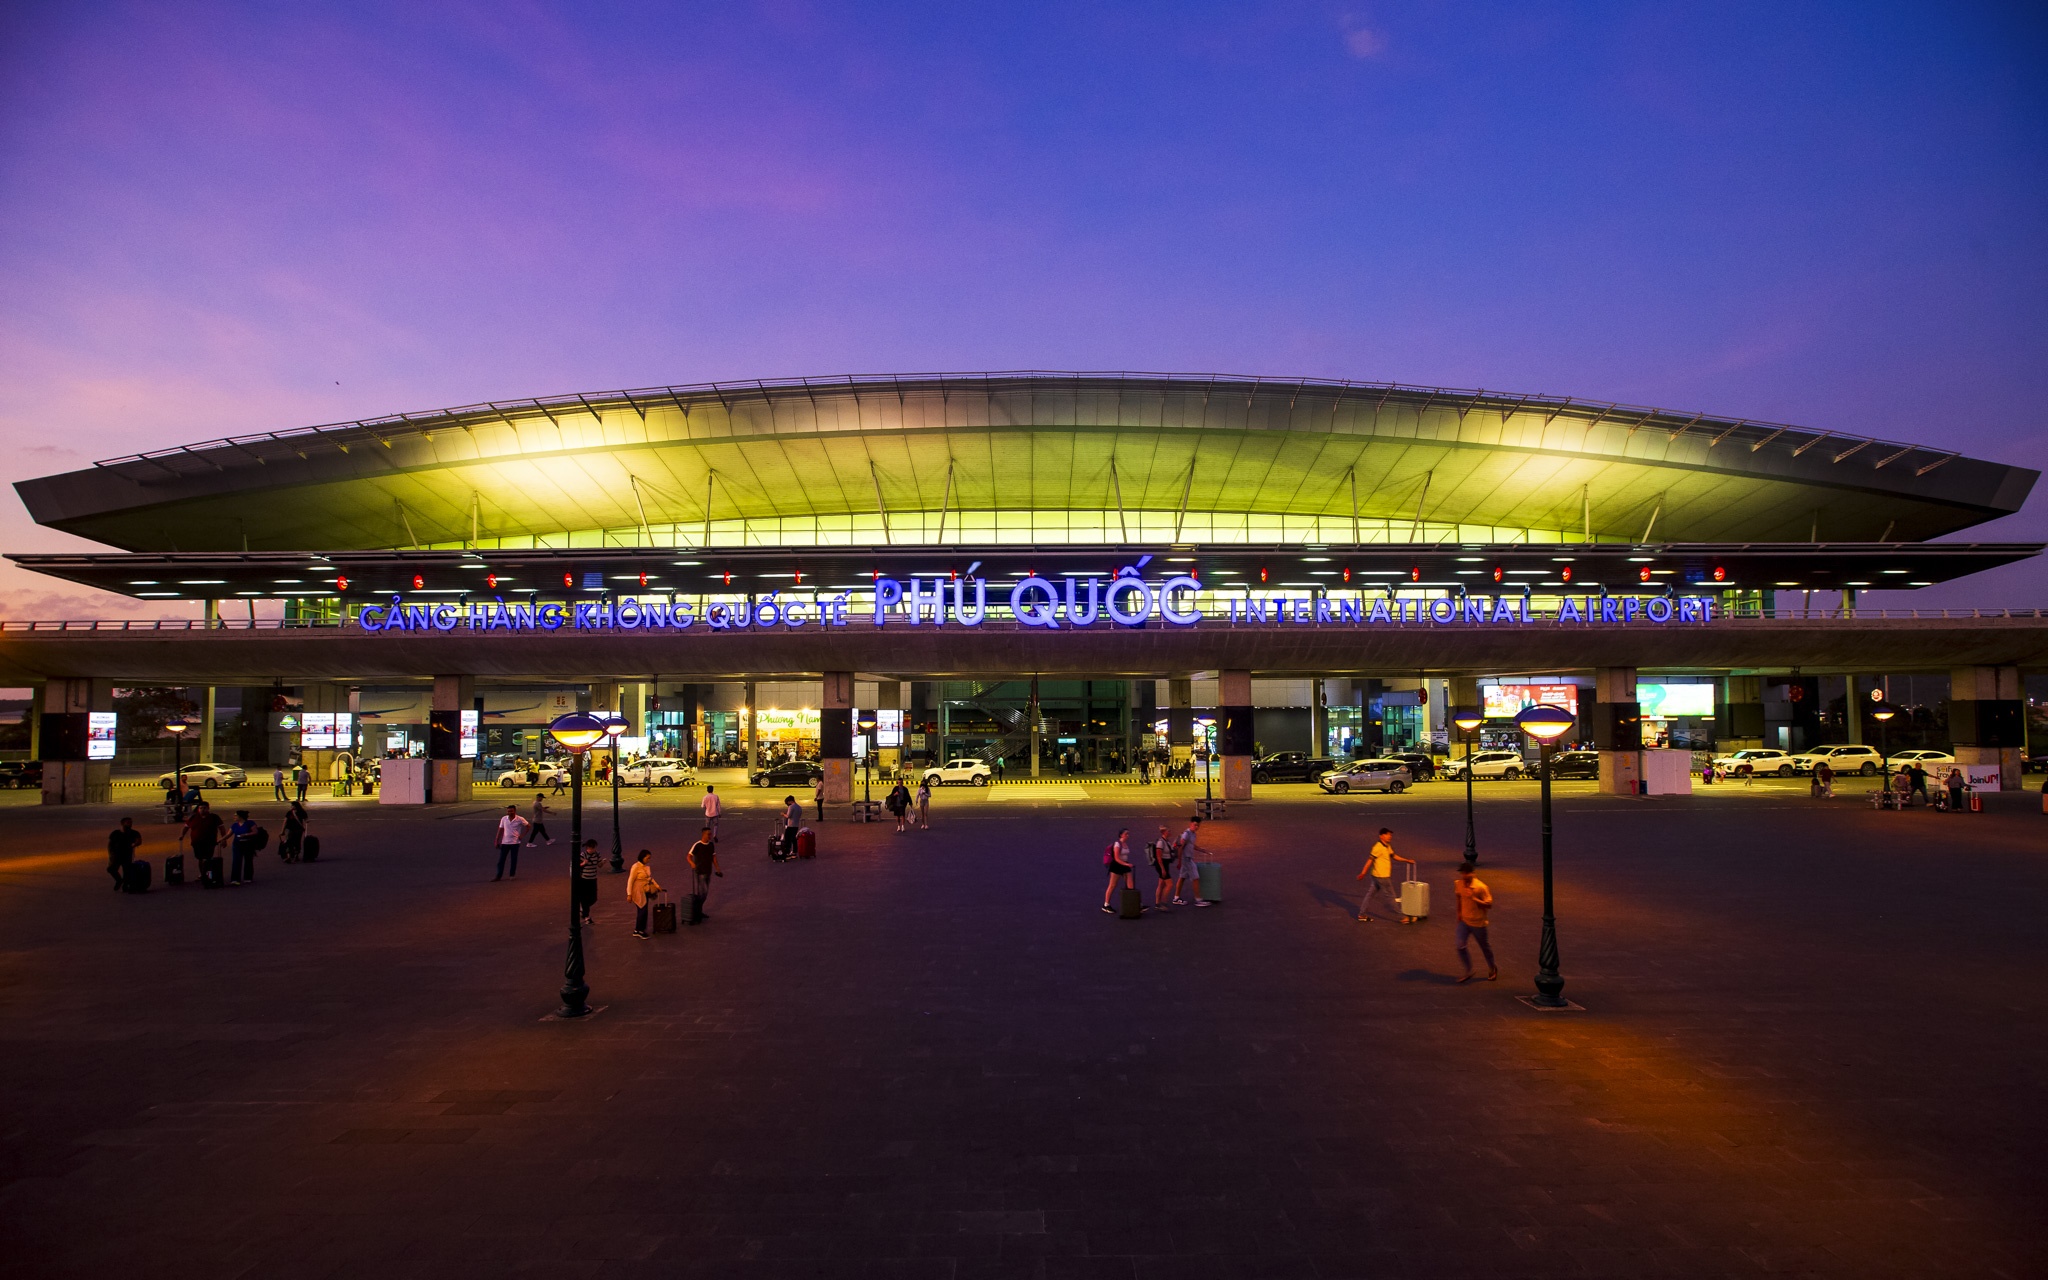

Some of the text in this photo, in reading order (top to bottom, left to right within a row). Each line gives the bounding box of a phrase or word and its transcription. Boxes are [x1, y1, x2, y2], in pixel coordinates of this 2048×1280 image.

[359, 555, 1714, 631] CẢNG HÀNG KHÔNG QUỐC TẾ PHÚ QUỐC INTERNATIONAL AIRPORT
